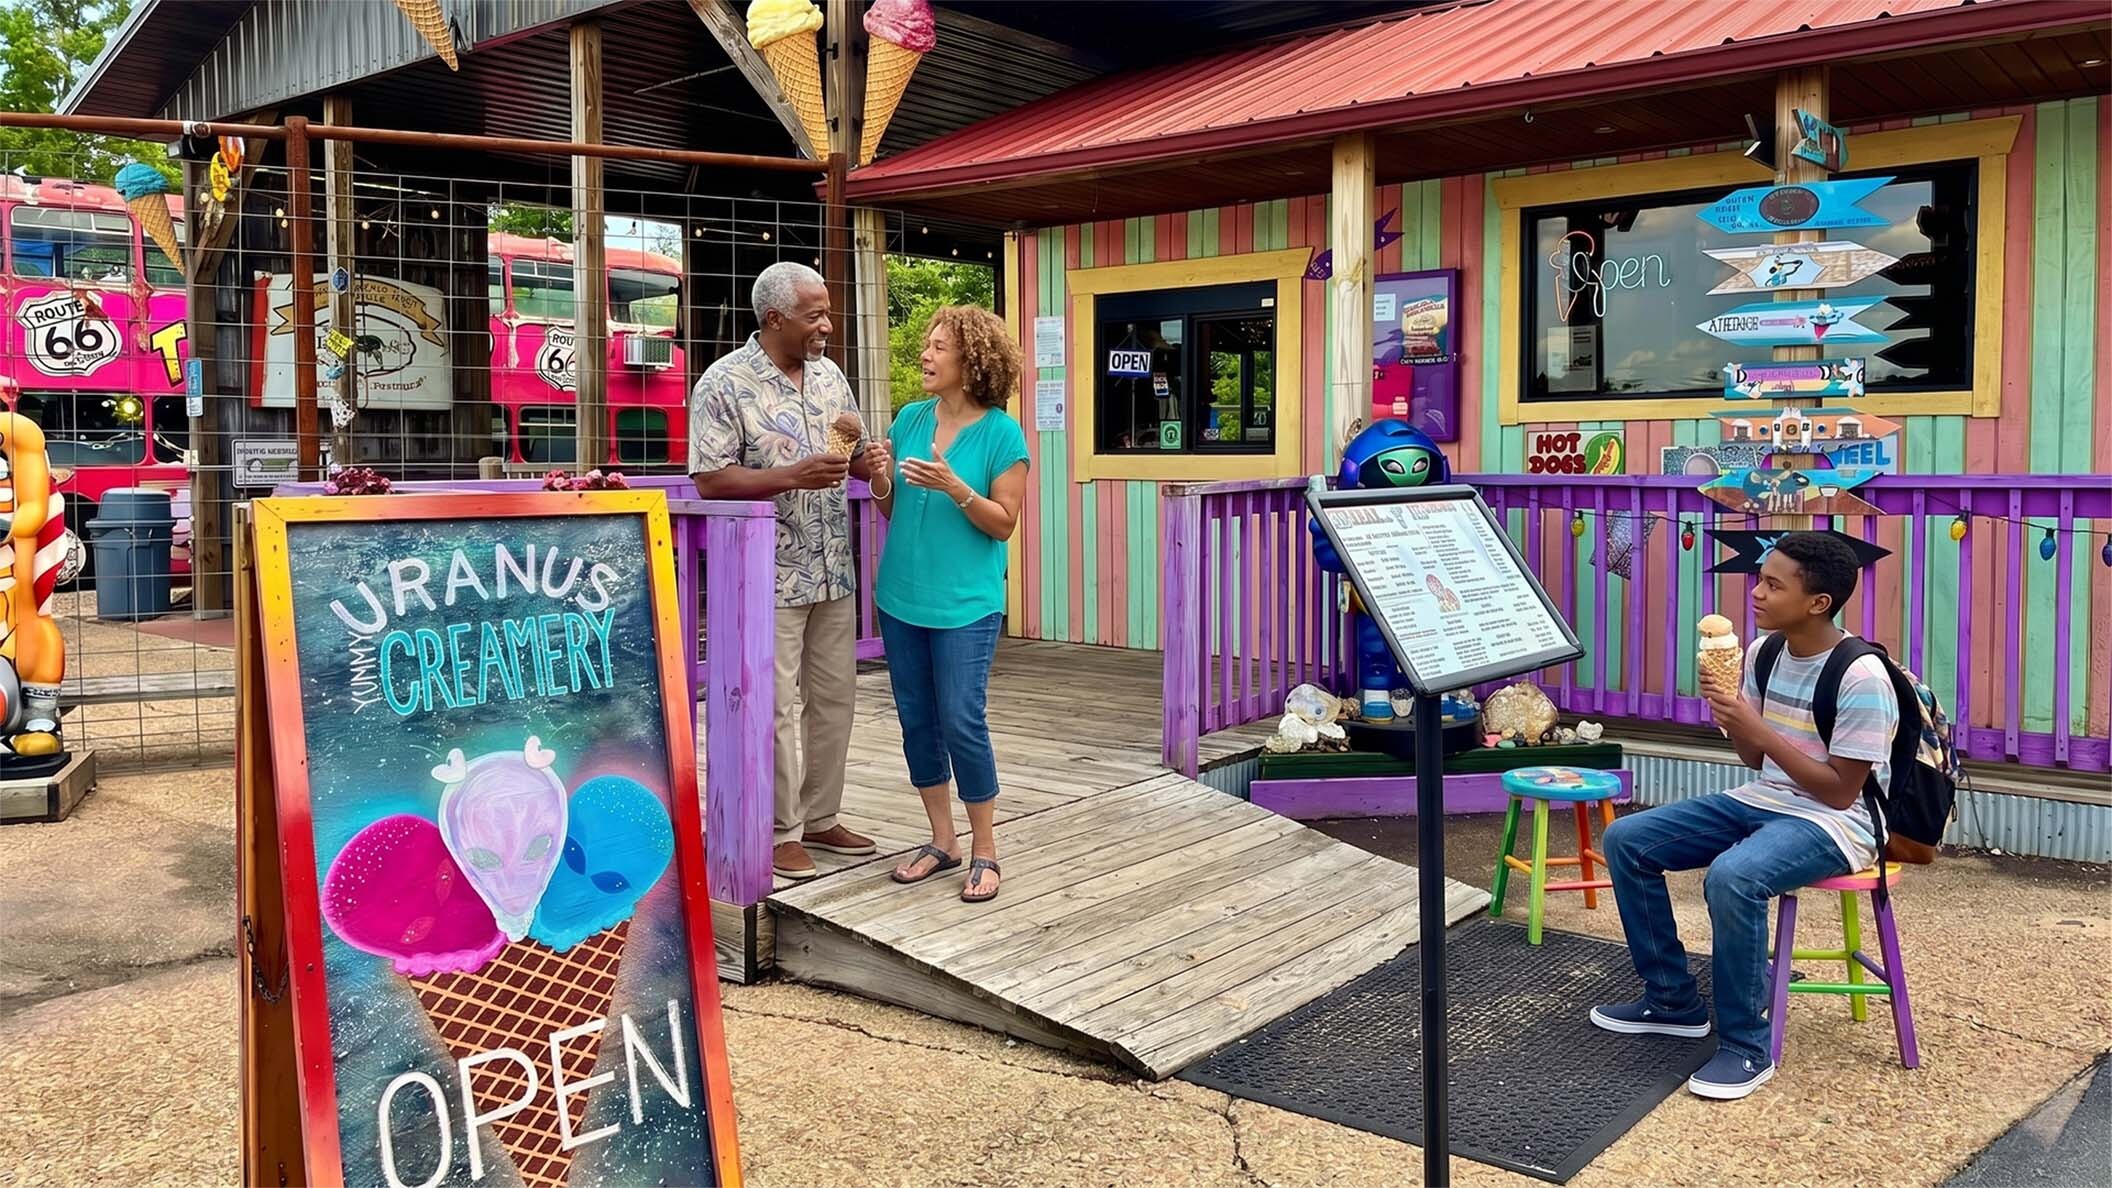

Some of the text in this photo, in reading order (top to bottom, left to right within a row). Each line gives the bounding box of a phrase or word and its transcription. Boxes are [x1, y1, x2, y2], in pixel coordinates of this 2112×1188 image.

[34, 299, 85, 323] ROUTE
[45, 319, 103, 360] 66
[552, 333, 575, 347] ROU
[1111, 352, 1149, 372] OPEN
[1536, 432, 1581, 454] HOT
[1529, 454, 1587, 474] DOGS
[329, 542, 622, 635] URANUS
[348, 631, 383, 715] YUMMY
[379, 607, 616, 717] CREAMERY
[378, 998, 692, 1188] OPEN
